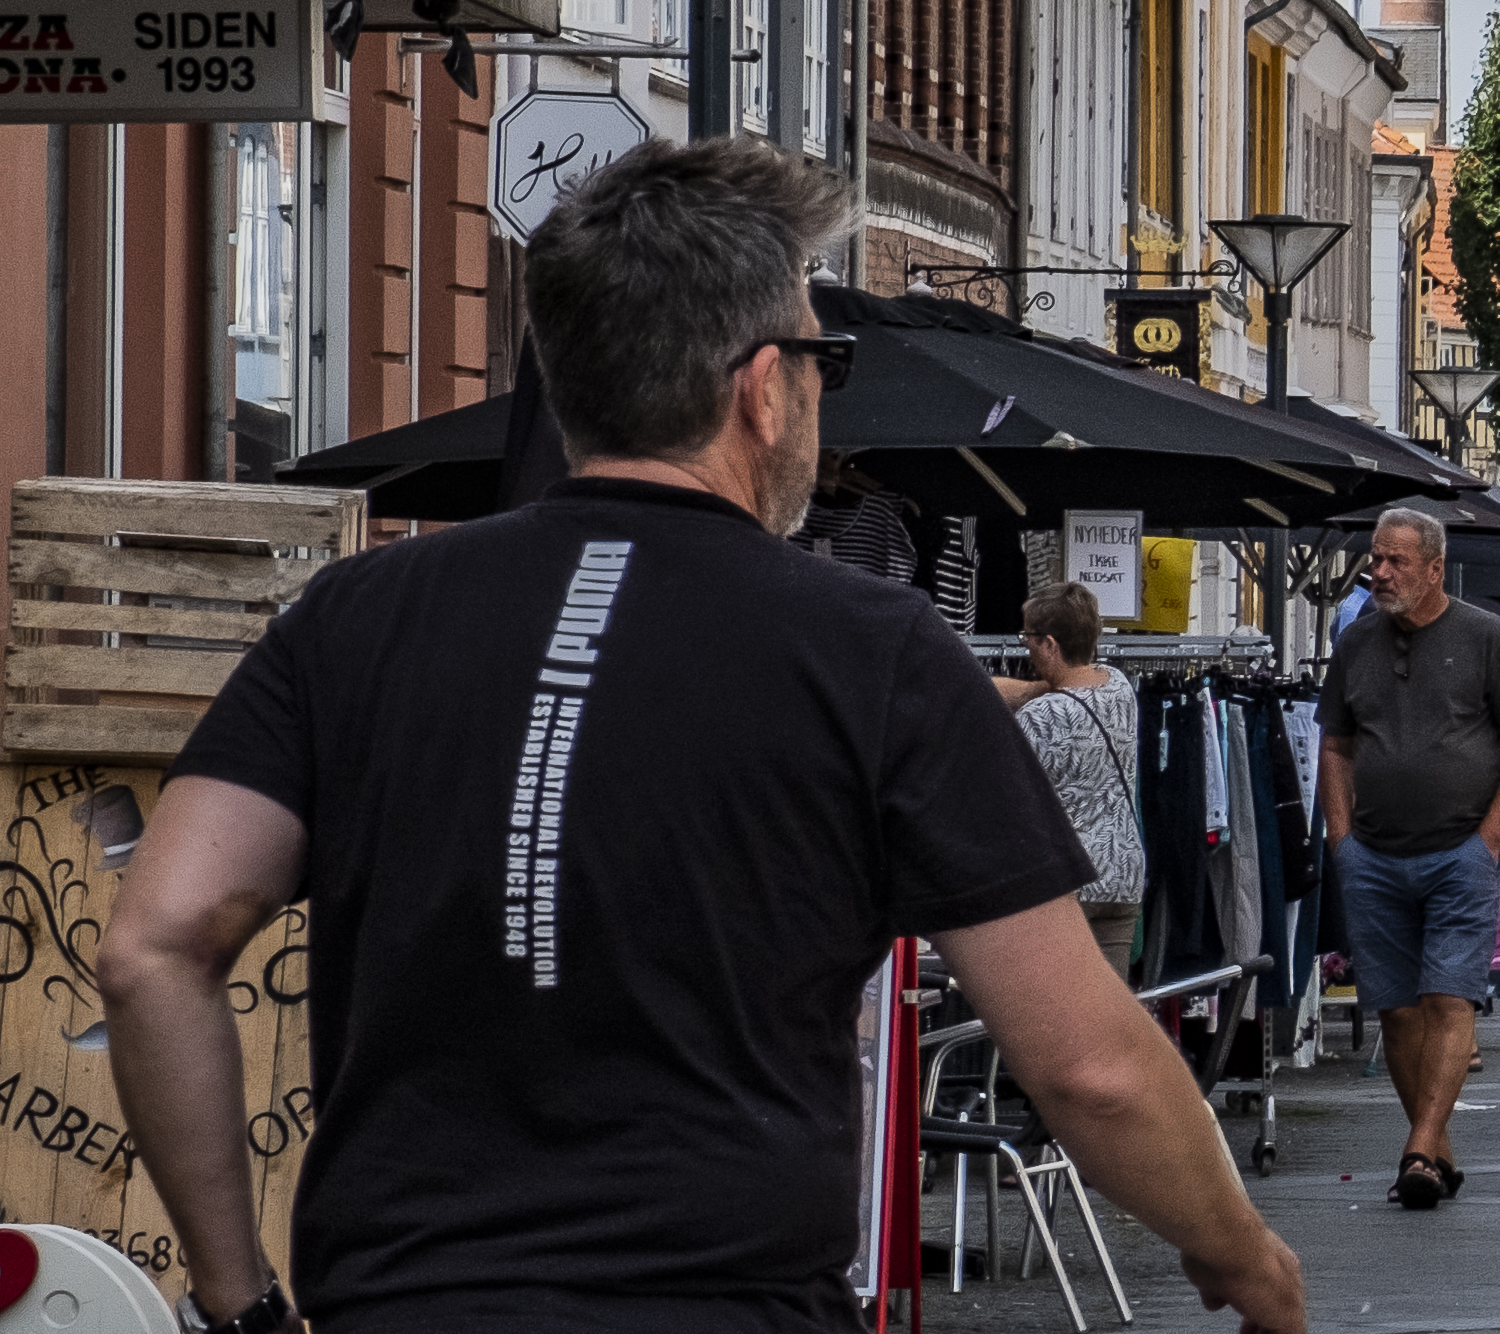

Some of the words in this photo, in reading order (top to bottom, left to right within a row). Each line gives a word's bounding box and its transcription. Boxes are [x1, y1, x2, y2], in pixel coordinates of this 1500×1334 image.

[134, 11, 276, 50] SIDEN
[156, 56, 256, 93] 1993
[1074, 525, 1137, 546] NYHEDER
[546, 541, 633, 662] PUMA
[18, 763, 110, 814] THE
[510, 693, 555, 828] ESTABLISHED
[535, 696, 583, 853] INTERNATIONAL
[506, 832, 531, 899] SINCE
[505, 902, 528, 957] 1948
[532, 858, 558, 987] REVOLUTION
